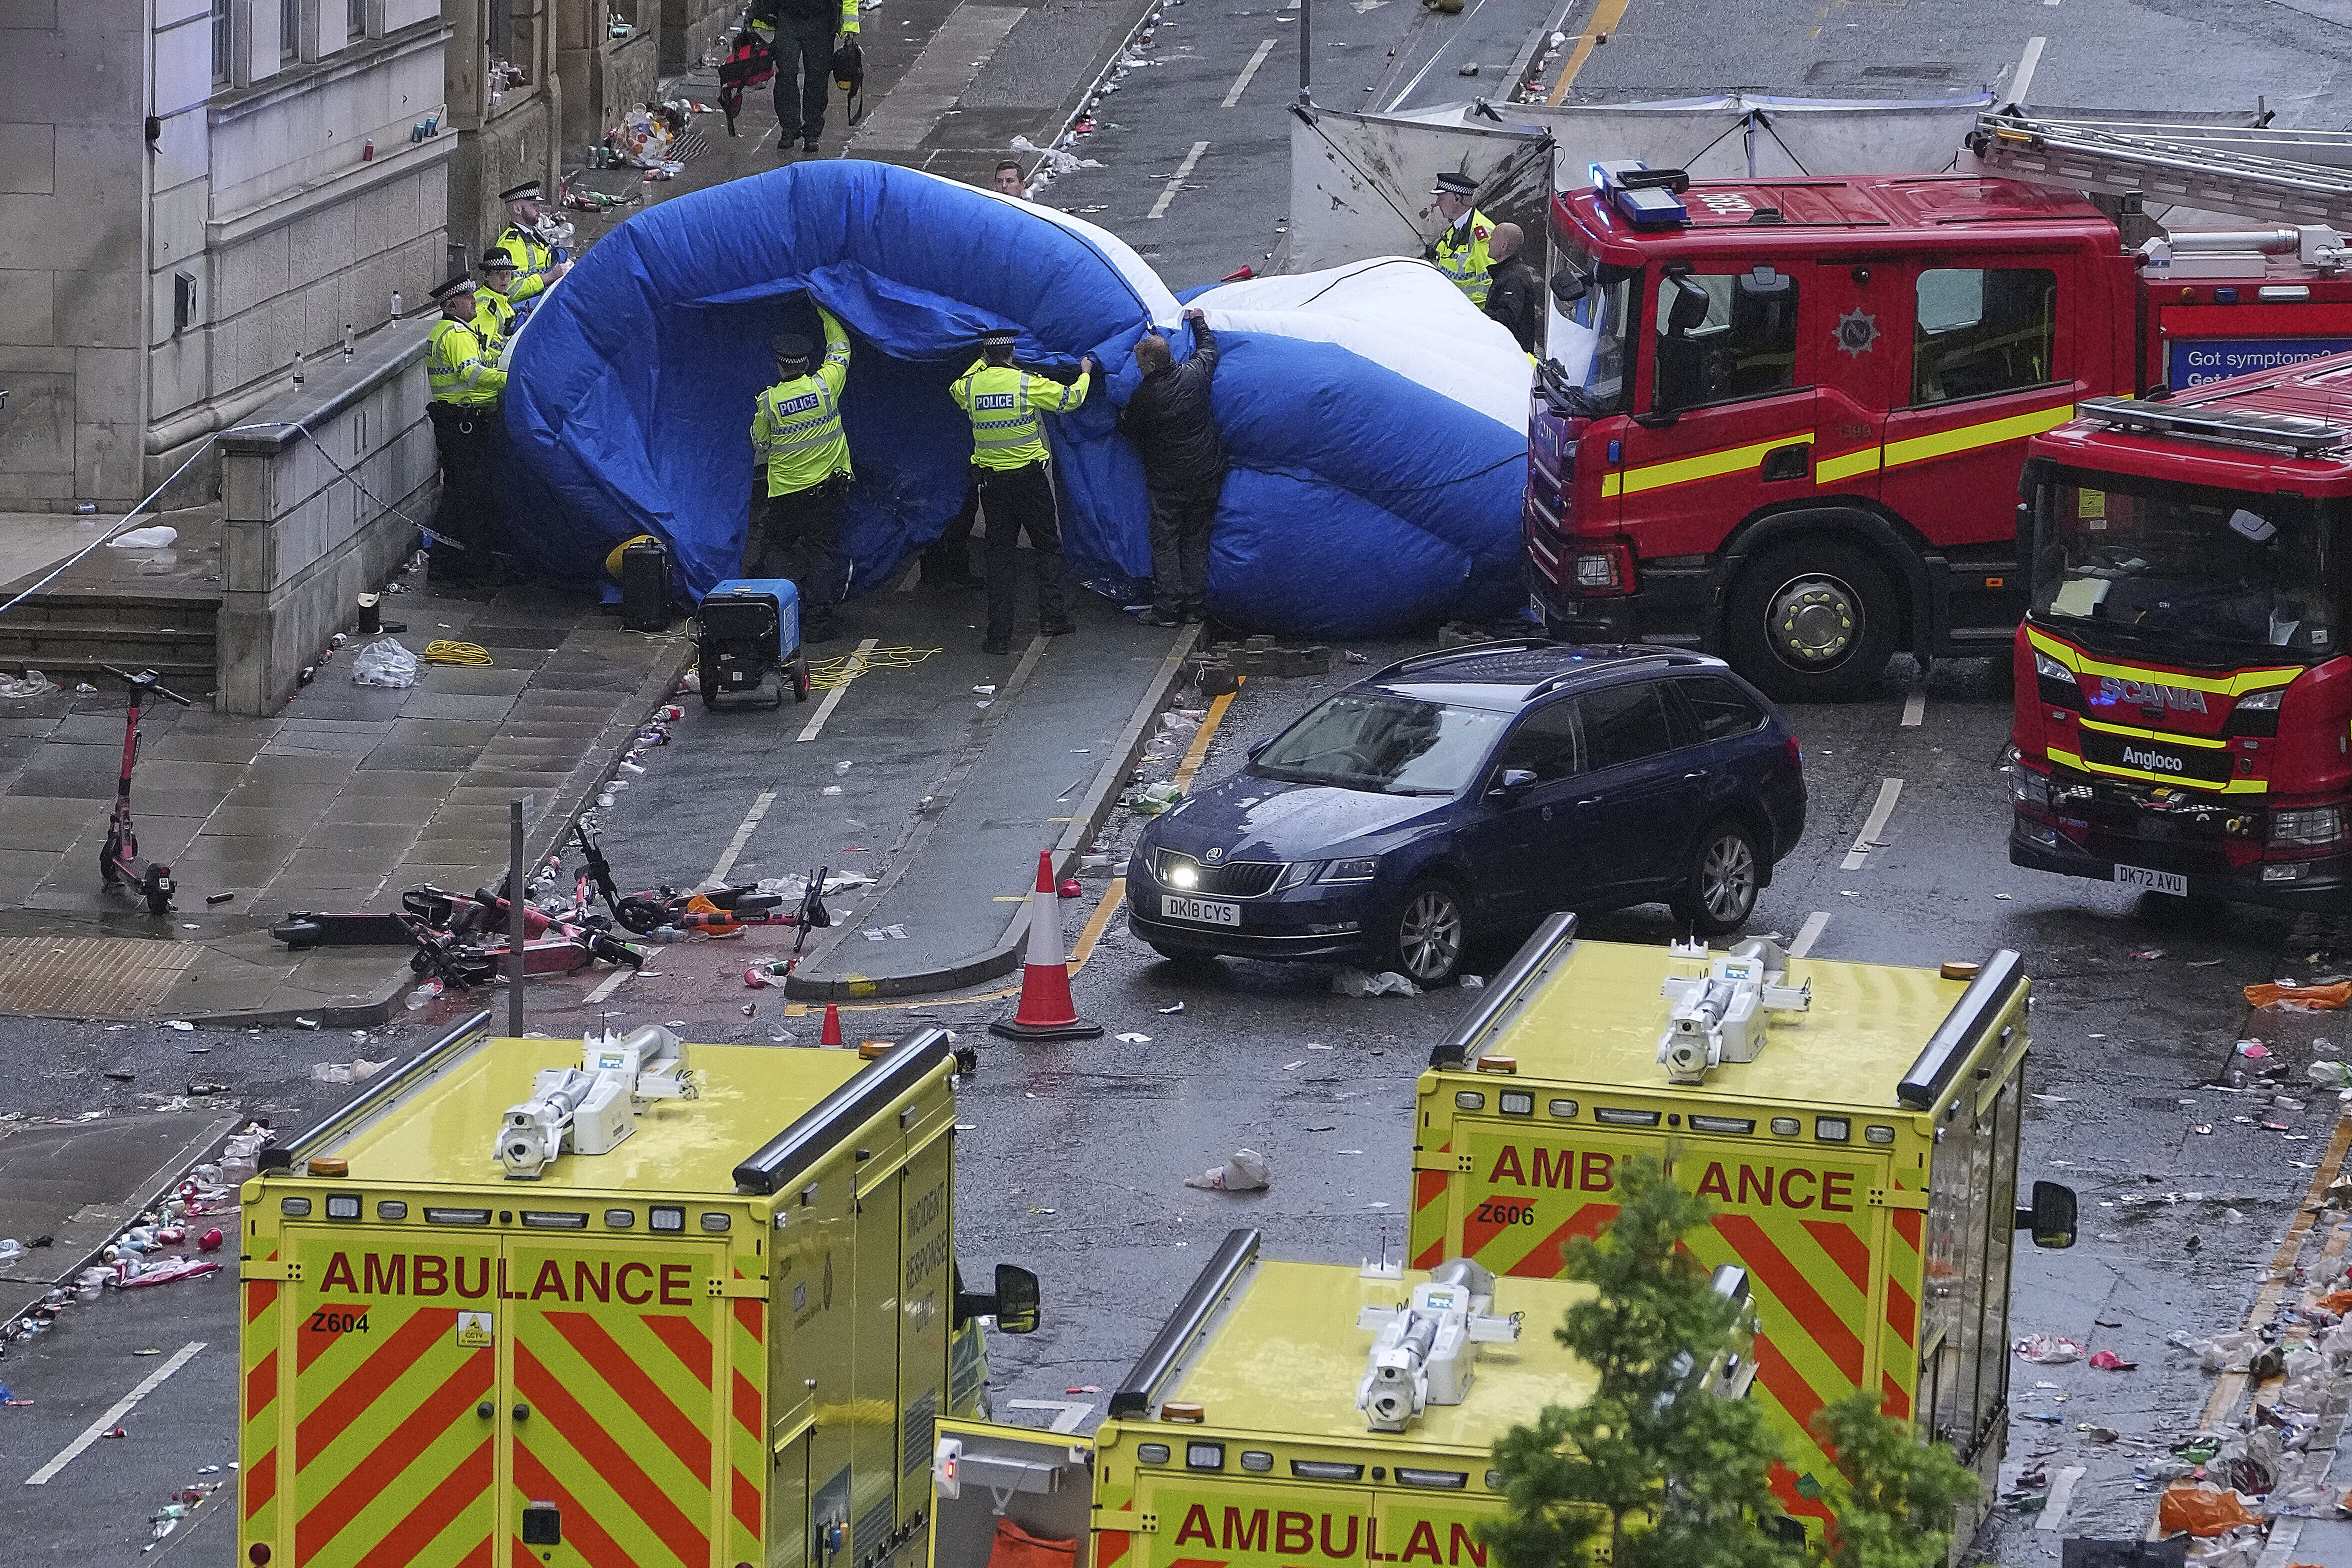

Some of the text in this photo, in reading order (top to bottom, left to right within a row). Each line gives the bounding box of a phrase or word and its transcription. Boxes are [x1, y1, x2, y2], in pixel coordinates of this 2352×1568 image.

[1696, 194, 1754, 215] 1399
[2188, 351, 2221, 366] Got
[780, 395, 818, 415] POLICE
[976, 395, 1013, 408] POLICE
[2100, 676, 2208, 714] SCANIA
[2122, 746, 2183, 771] Angloco
[2120, 867, 2182, 892] DK72 AVU
[1170, 899, 1231, 922] DK18 CYS
[1488, 1145, 1854, 1212] AMBANCE
[1477, 1204, 1534, 1226] Z606
[320, 1252, 692, 1306] AMBULANCE
[310, 1312, 370, 1334] Z604
[1174, 1503, 1488, 1568] AMBULAN
